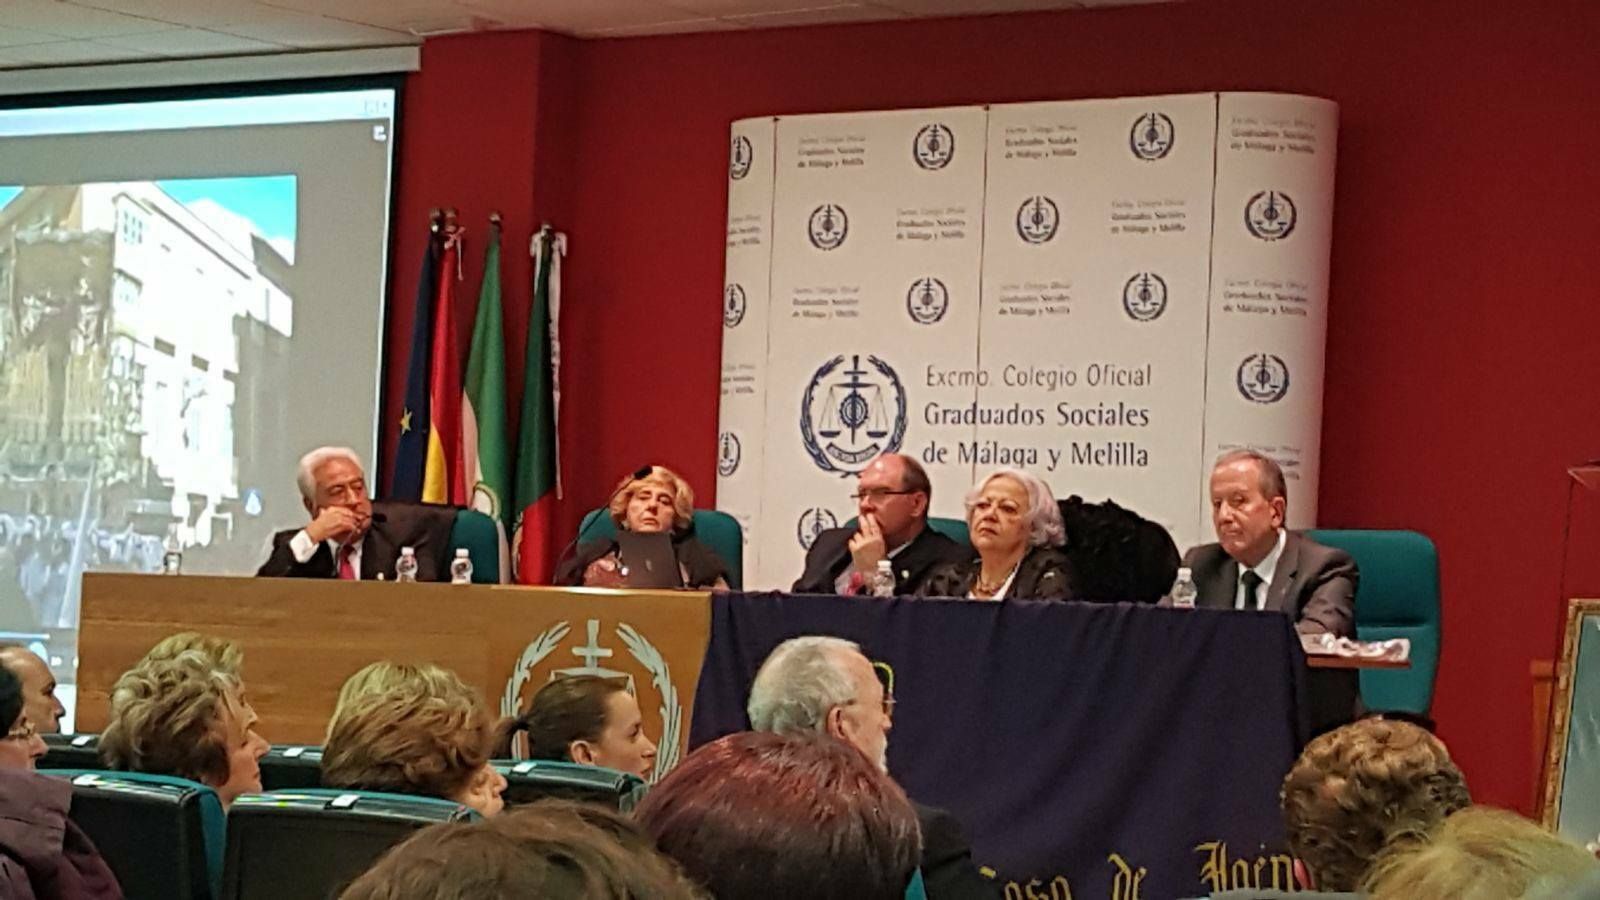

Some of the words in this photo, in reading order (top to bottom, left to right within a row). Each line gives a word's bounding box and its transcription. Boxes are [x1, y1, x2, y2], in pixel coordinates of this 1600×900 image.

[1003, 363, 1077, 392] Colegio
[1087, 363, 1151, 387] Oficial
[924, 402, 1045, 426] Graduados
[1056, 401, 1150, 427] Sociales
[922, 441, 948, 464] de
[958, 440, 1038, 468] Málaga
[1047, 448, 1061, 472] y
[1071, 441, 1149, 467] Melilla
